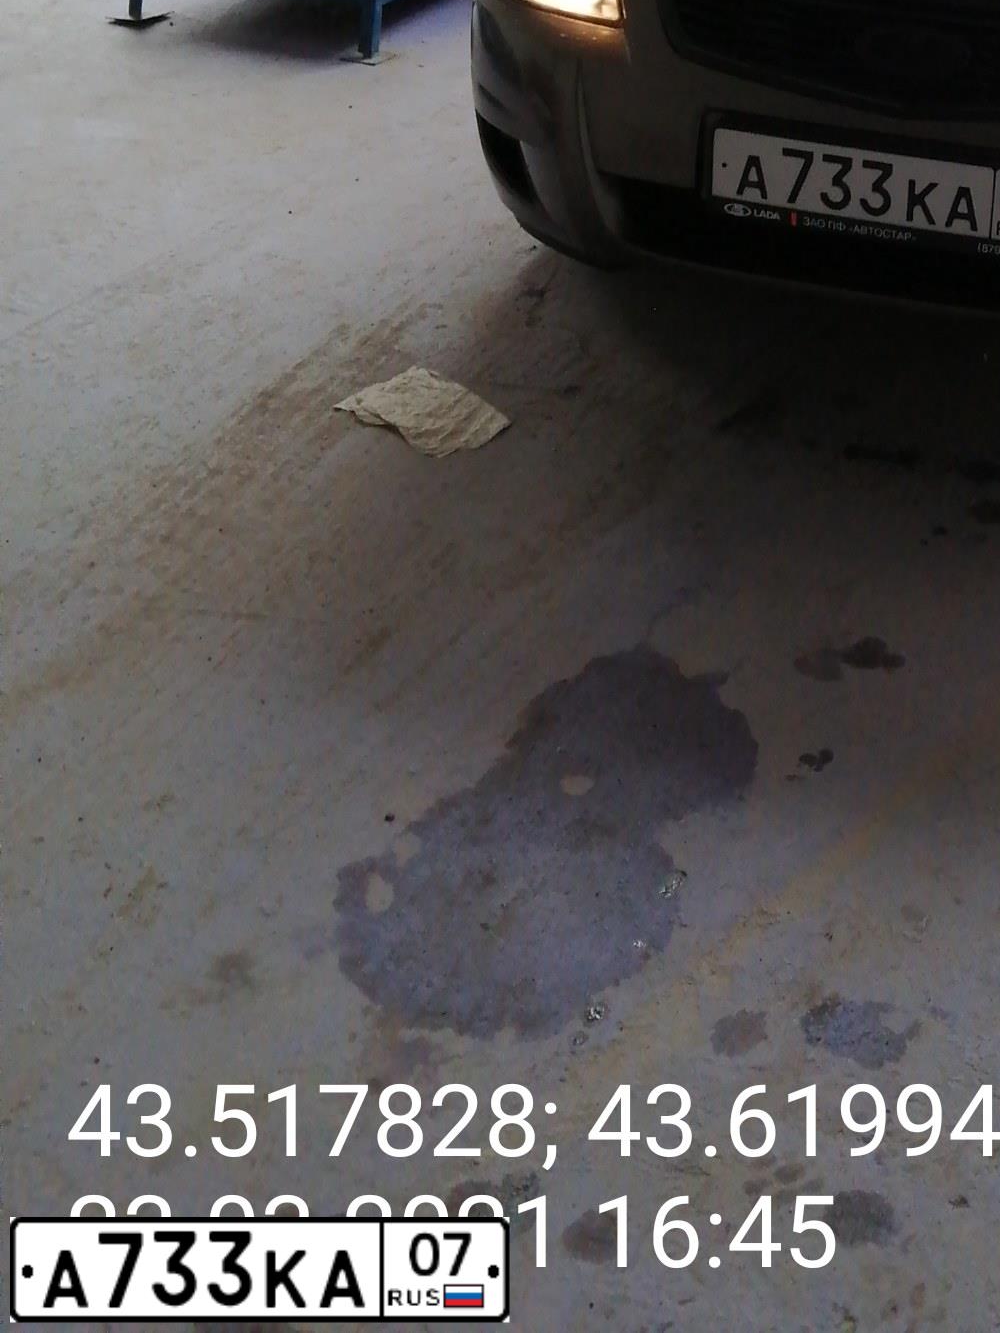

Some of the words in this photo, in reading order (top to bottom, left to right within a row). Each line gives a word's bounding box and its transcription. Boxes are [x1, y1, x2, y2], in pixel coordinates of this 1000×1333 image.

[735, 147, 978, 232] А733КА
[753, 209, 781, 220] LADA
[803, 217, 826, 228] ЗАО
